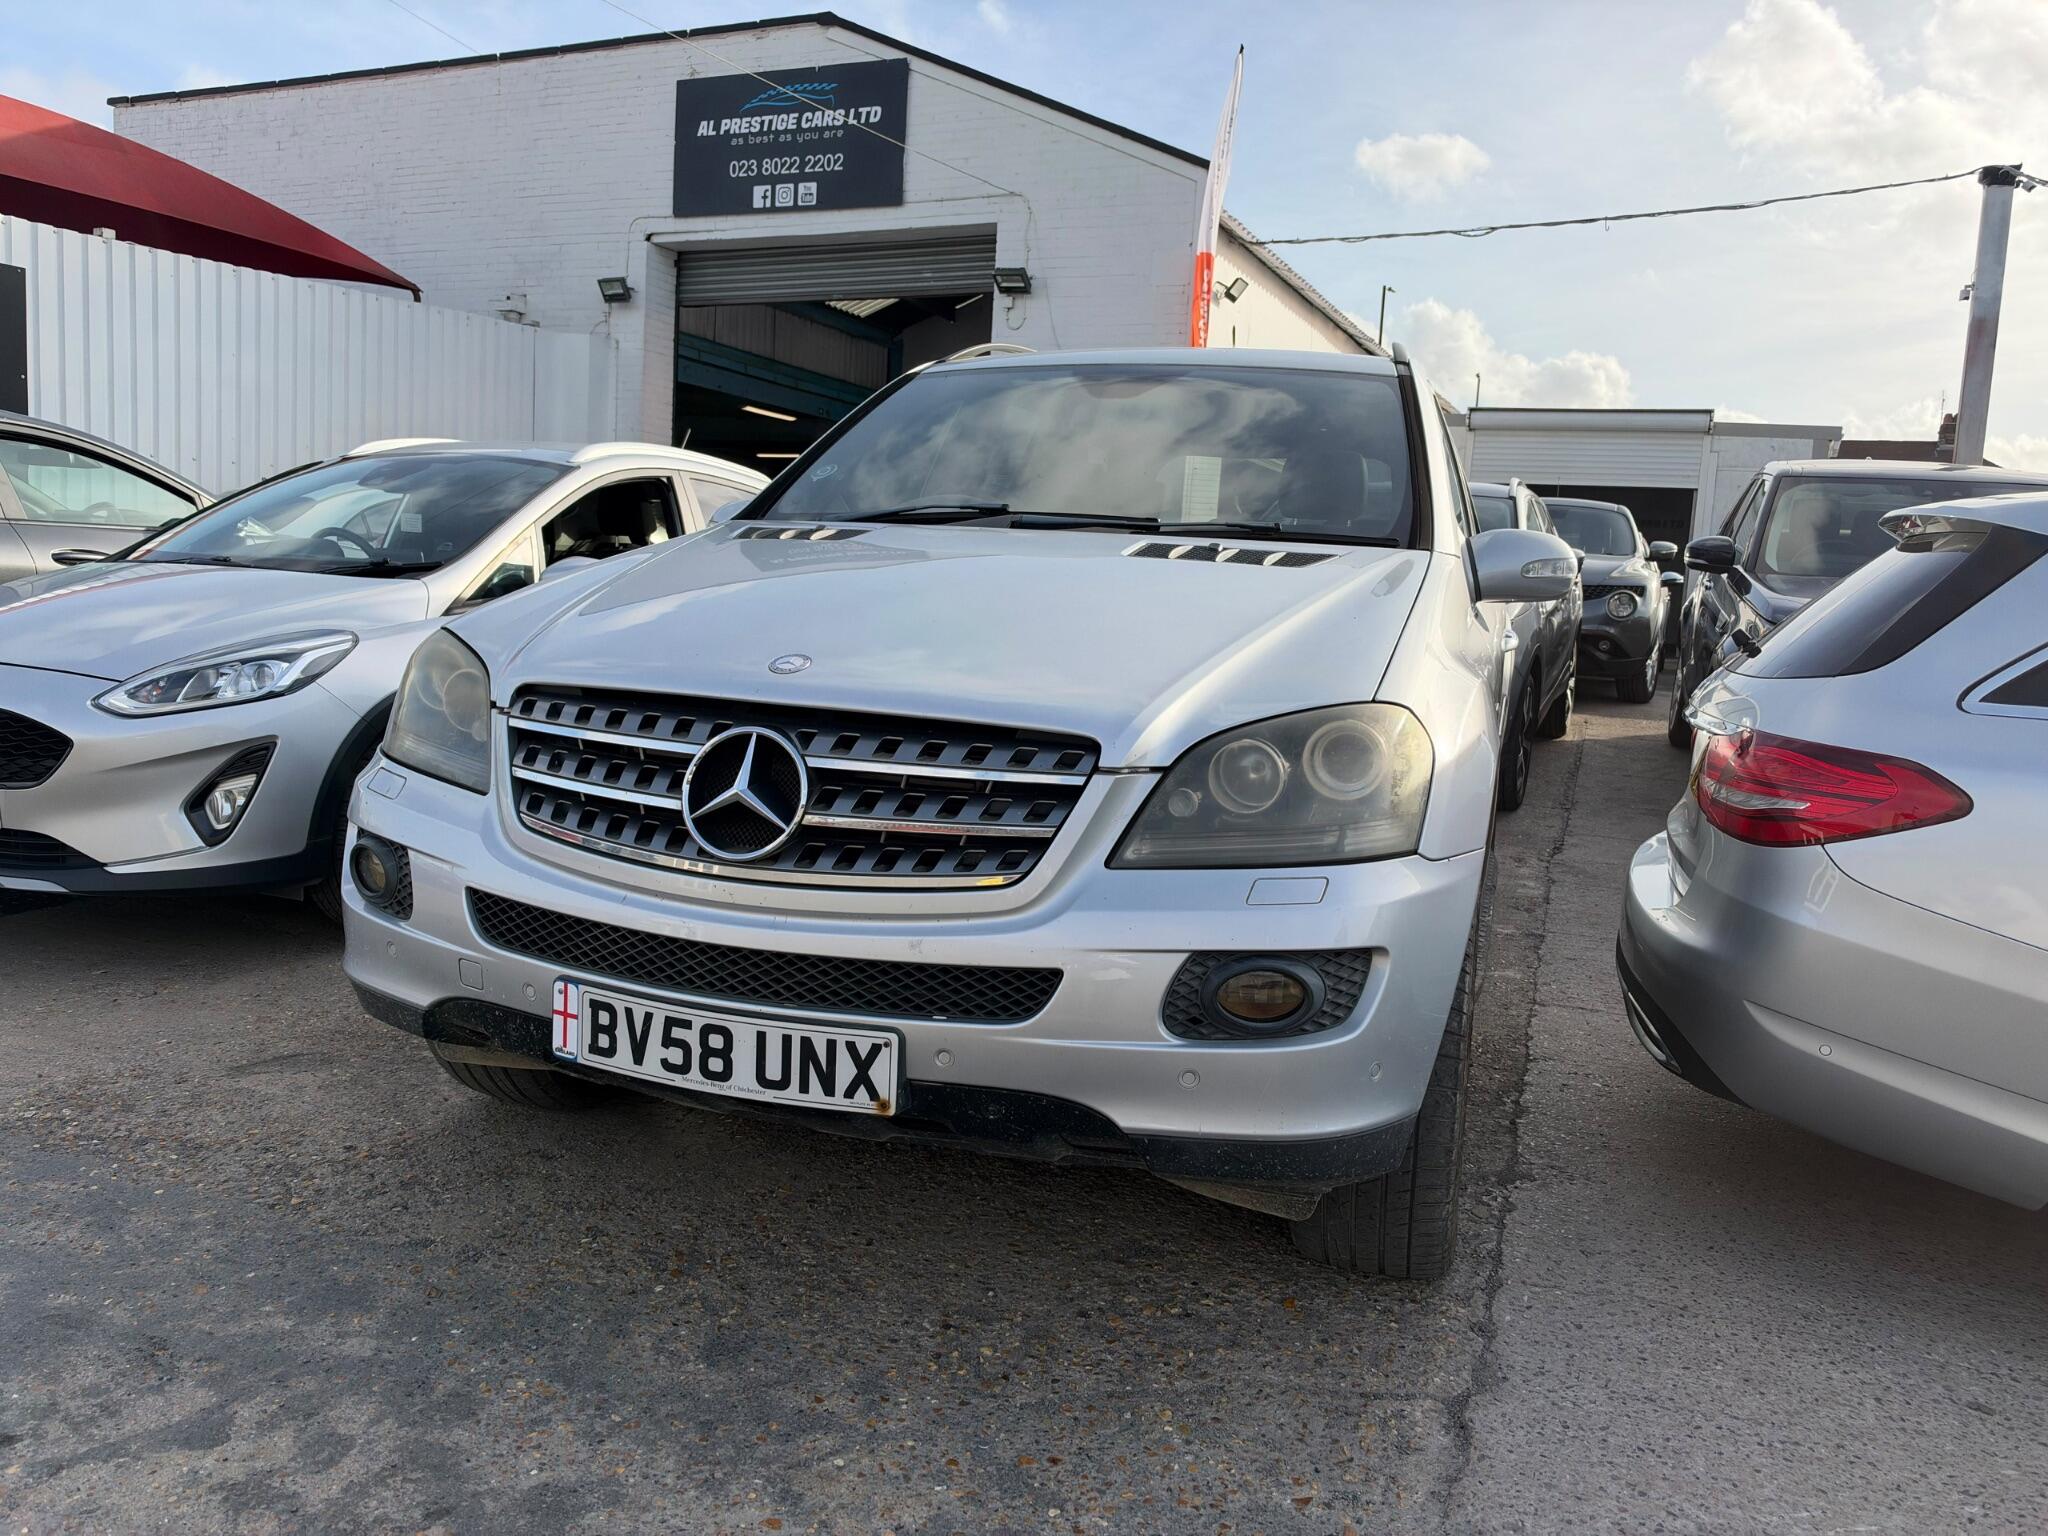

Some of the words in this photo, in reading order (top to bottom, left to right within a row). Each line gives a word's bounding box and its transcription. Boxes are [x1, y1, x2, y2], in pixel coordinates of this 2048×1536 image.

[697, 120, 716, 136] AL
[719, 113, 799, 135] PRESTIGE
[801, 109, 845, 129] CARS
[848, 106, 882, 125] LTD
[730, 137, 744, 146] as
[749, 134, 774, 144] best
[778, 134, 792, 142] as
[796, 130, 819, 143] you
[823, 129, 844, 139] are
[729, 160, 757, 178] 023
[762, 157, 800, 176] 8022
[804, 153, 844, 173] 2202
[588, 998, 734, 1083] BV58
[755, 1030, 884, 1103] UNX
[733, 1085, 767, 1095] Chichester
